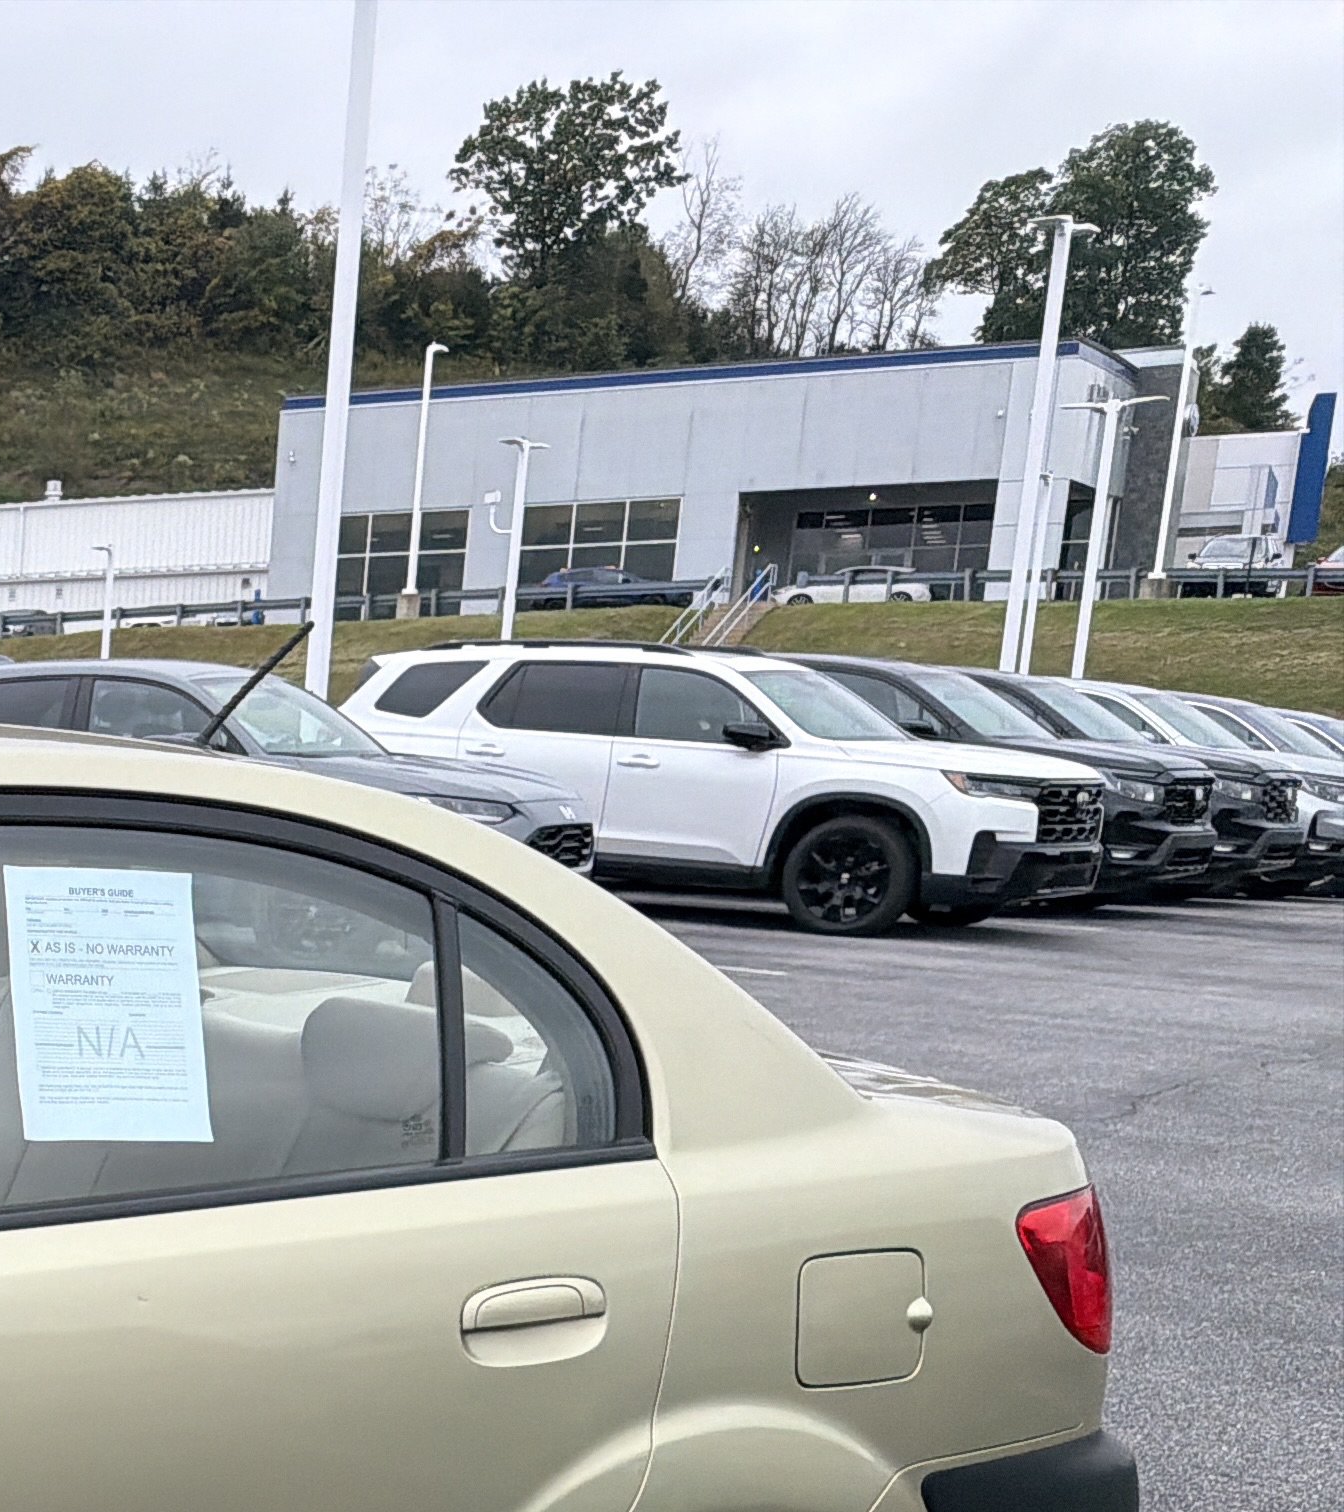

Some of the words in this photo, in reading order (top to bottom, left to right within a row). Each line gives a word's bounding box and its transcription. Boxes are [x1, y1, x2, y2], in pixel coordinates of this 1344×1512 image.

[68, 887, 106, 897] BUYER'S
[107, 888, 134, 898] GUIDE
[30, 940, 40, 954] X
[44, 942, 61, 953] AS
[64, 942, 76, 954] IS
[86, 943, 105, 955] NO
[107, 943, 174, 957] WARRANTY
[46, 973, 114, 986] WARRANTY
[76, 1025, 145, 1059] N/A
